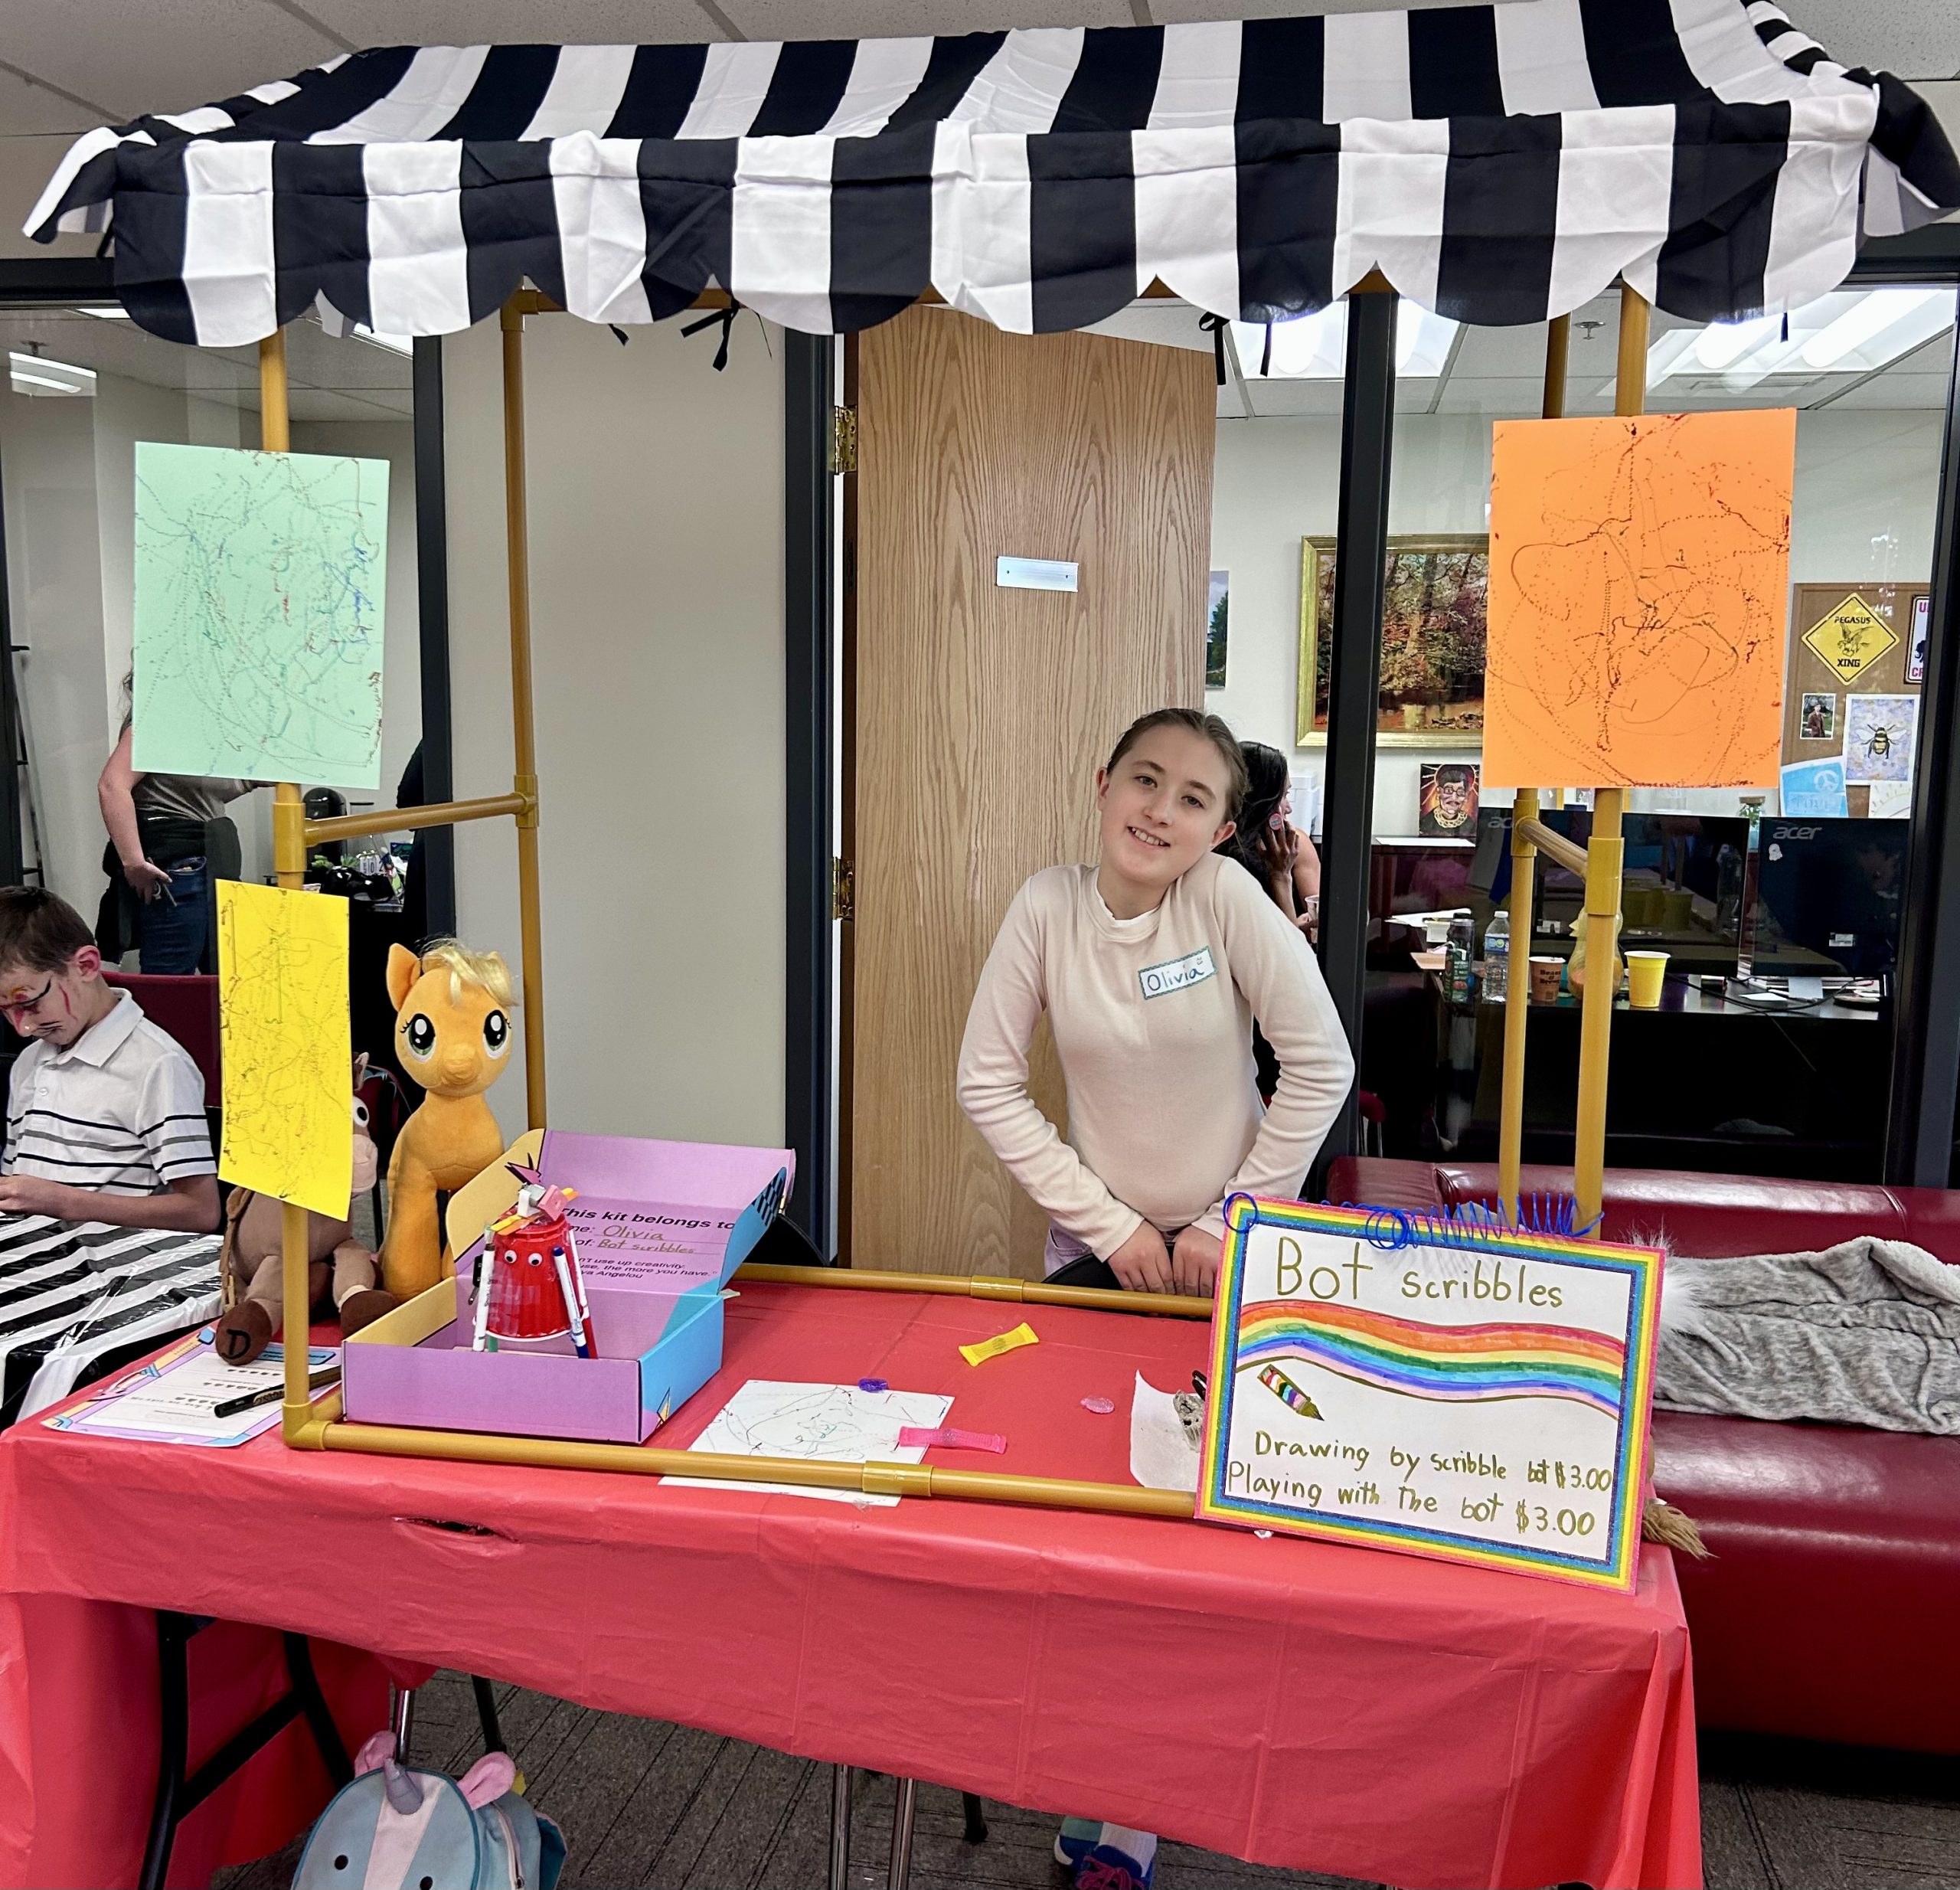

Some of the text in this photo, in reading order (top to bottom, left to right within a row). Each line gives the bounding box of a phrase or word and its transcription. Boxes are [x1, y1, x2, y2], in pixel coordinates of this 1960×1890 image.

[1834, 616, 1871, 624] PEGASUS
[1837, 659, 1860, 668] XING
[1772, 827, 1822, 840] acer
[1147, 964, 1204, 991] Olivia
[601, 1211, 629, 1221] kit
[632, 1213, 711, 1230] belongs
[603, 1225, 665, 1241] Olivia
[597, 1238, 628, 1249] Bot
[596, 1270, 643, 1279] Angelou
[1277, 1236, 1563, 1308] Bot scribbles
[1255, 1430, 1370, 1472] Drawing
[1390, 1446, 1420, 1483] by
[1527, 1459, 1550, 1484] bot
[1228, 1460, 1322, 1508] Playing
[1338, 1480, 1380, 1505] with
[1461, 1493, 1504, 1522] bot
[1516, 1499, 1595, 1536] $3.00
